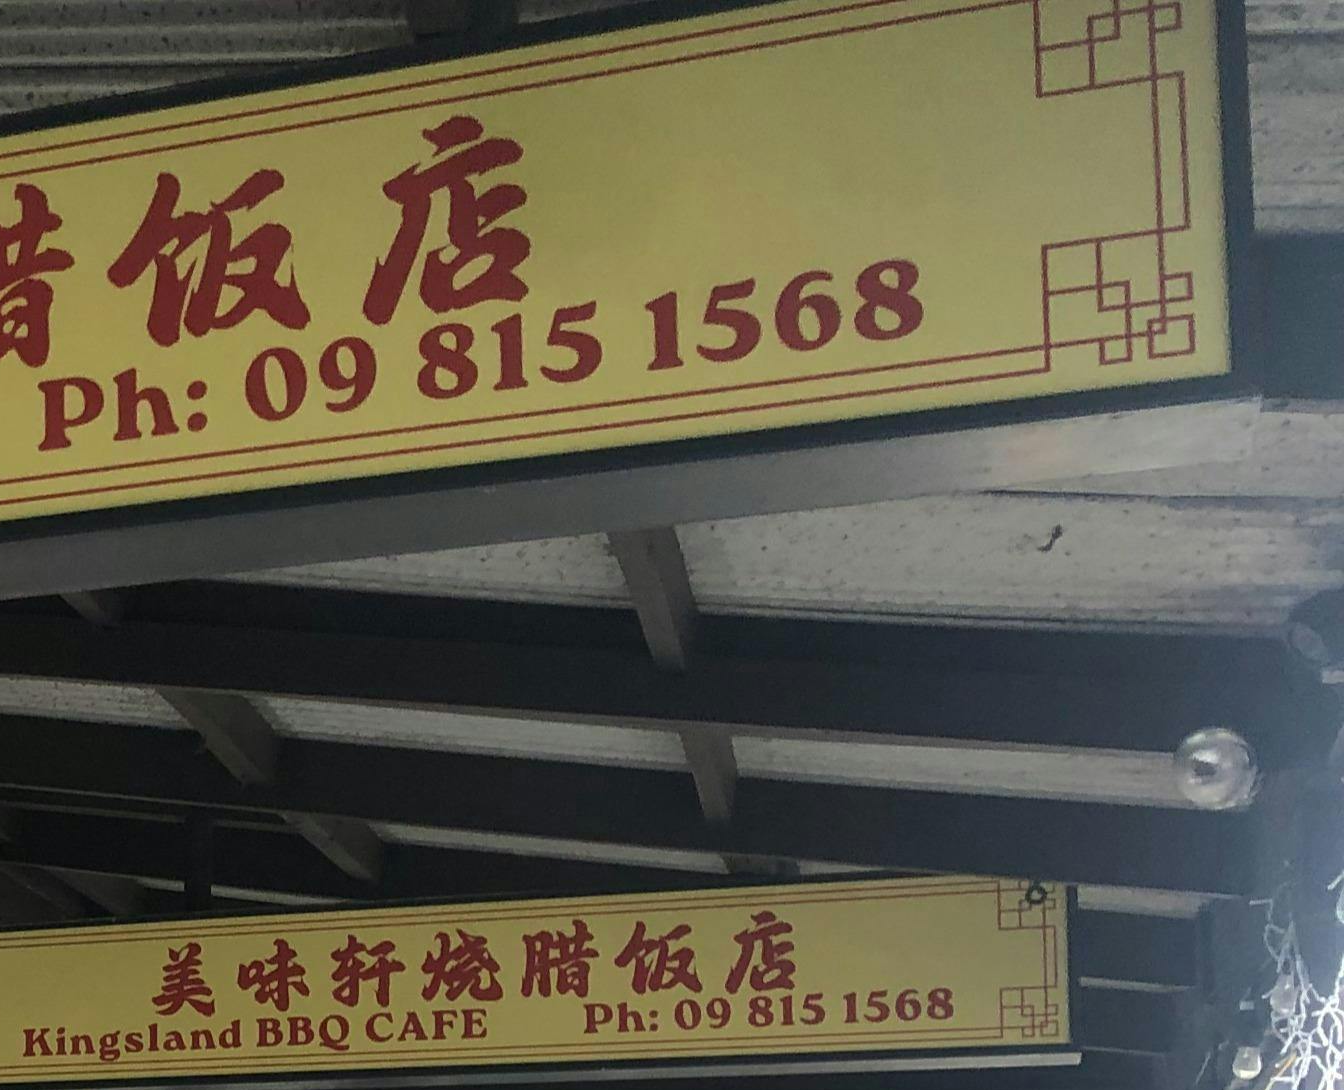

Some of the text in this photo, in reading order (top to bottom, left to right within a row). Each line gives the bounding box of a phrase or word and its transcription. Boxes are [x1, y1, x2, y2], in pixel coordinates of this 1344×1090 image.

[37, 260, 926, 452] Ph: 09 815 1568
[152, 910, 797, 1017] 美味轩烧腊饭店
[22, 1008, 488, 1062] Kingsland BBQ CAFE
[583, 988, 955, 1034] Ph: 09 815 1568
